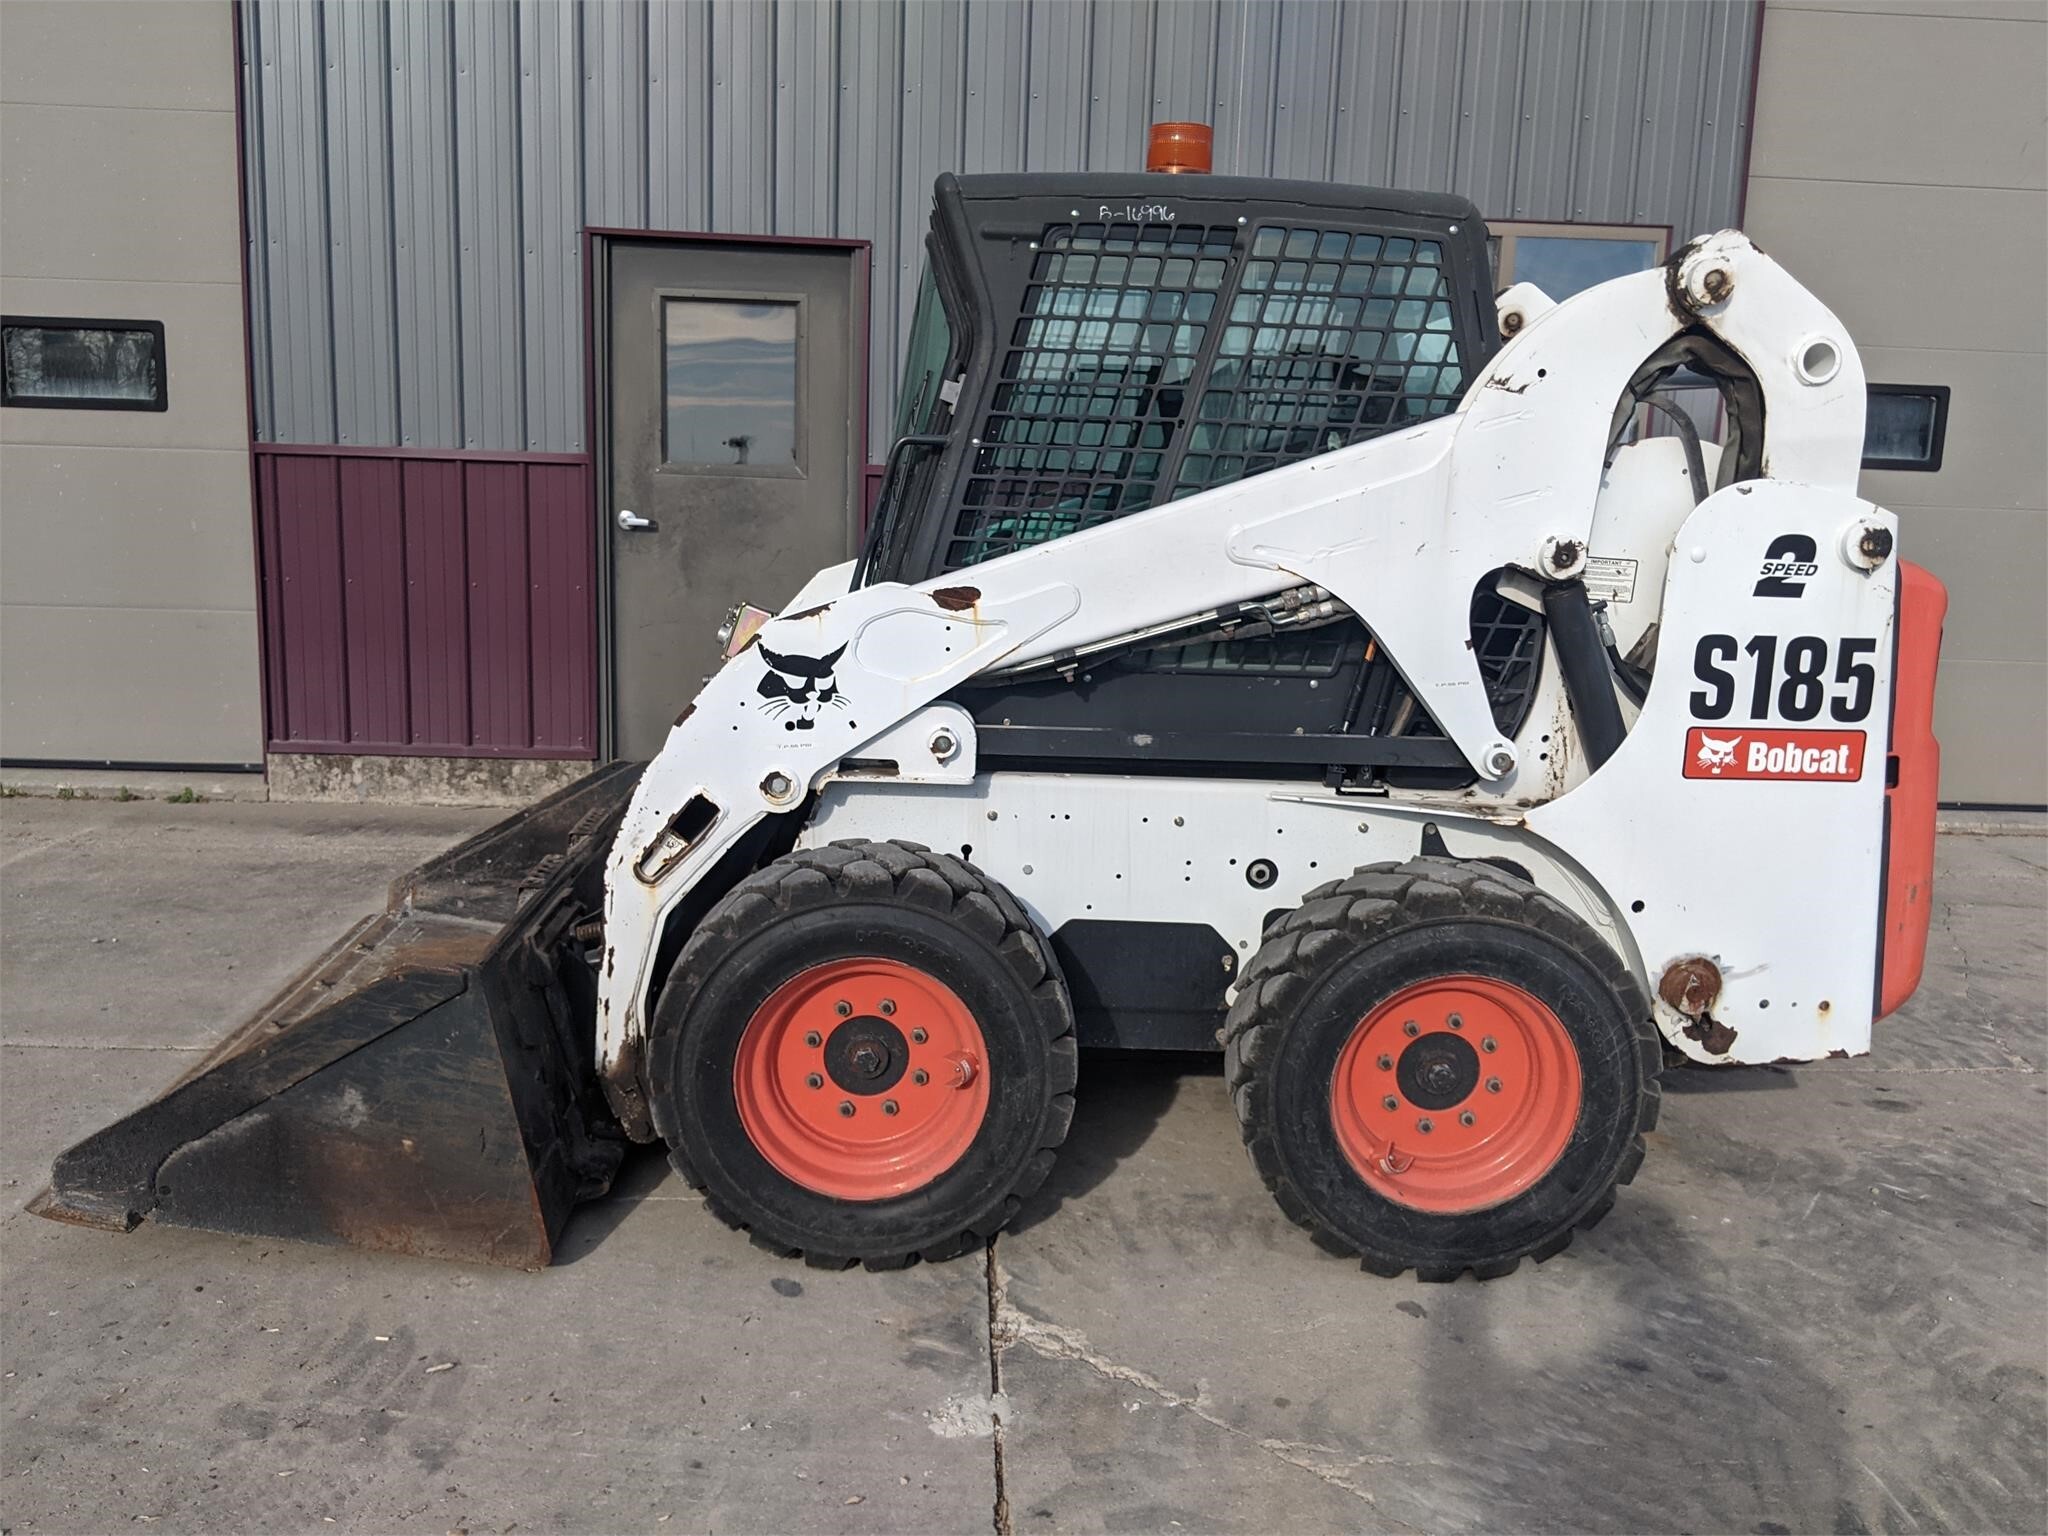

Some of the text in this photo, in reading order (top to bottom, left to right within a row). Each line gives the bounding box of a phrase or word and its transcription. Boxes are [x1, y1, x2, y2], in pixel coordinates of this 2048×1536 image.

[1752, 533, 1818, 599] 2
[1759, 561, 1819, 577] SPEED
[1689, 633, 1877, 723] S185
[1746, 741, 1850, 775] Bobcat
